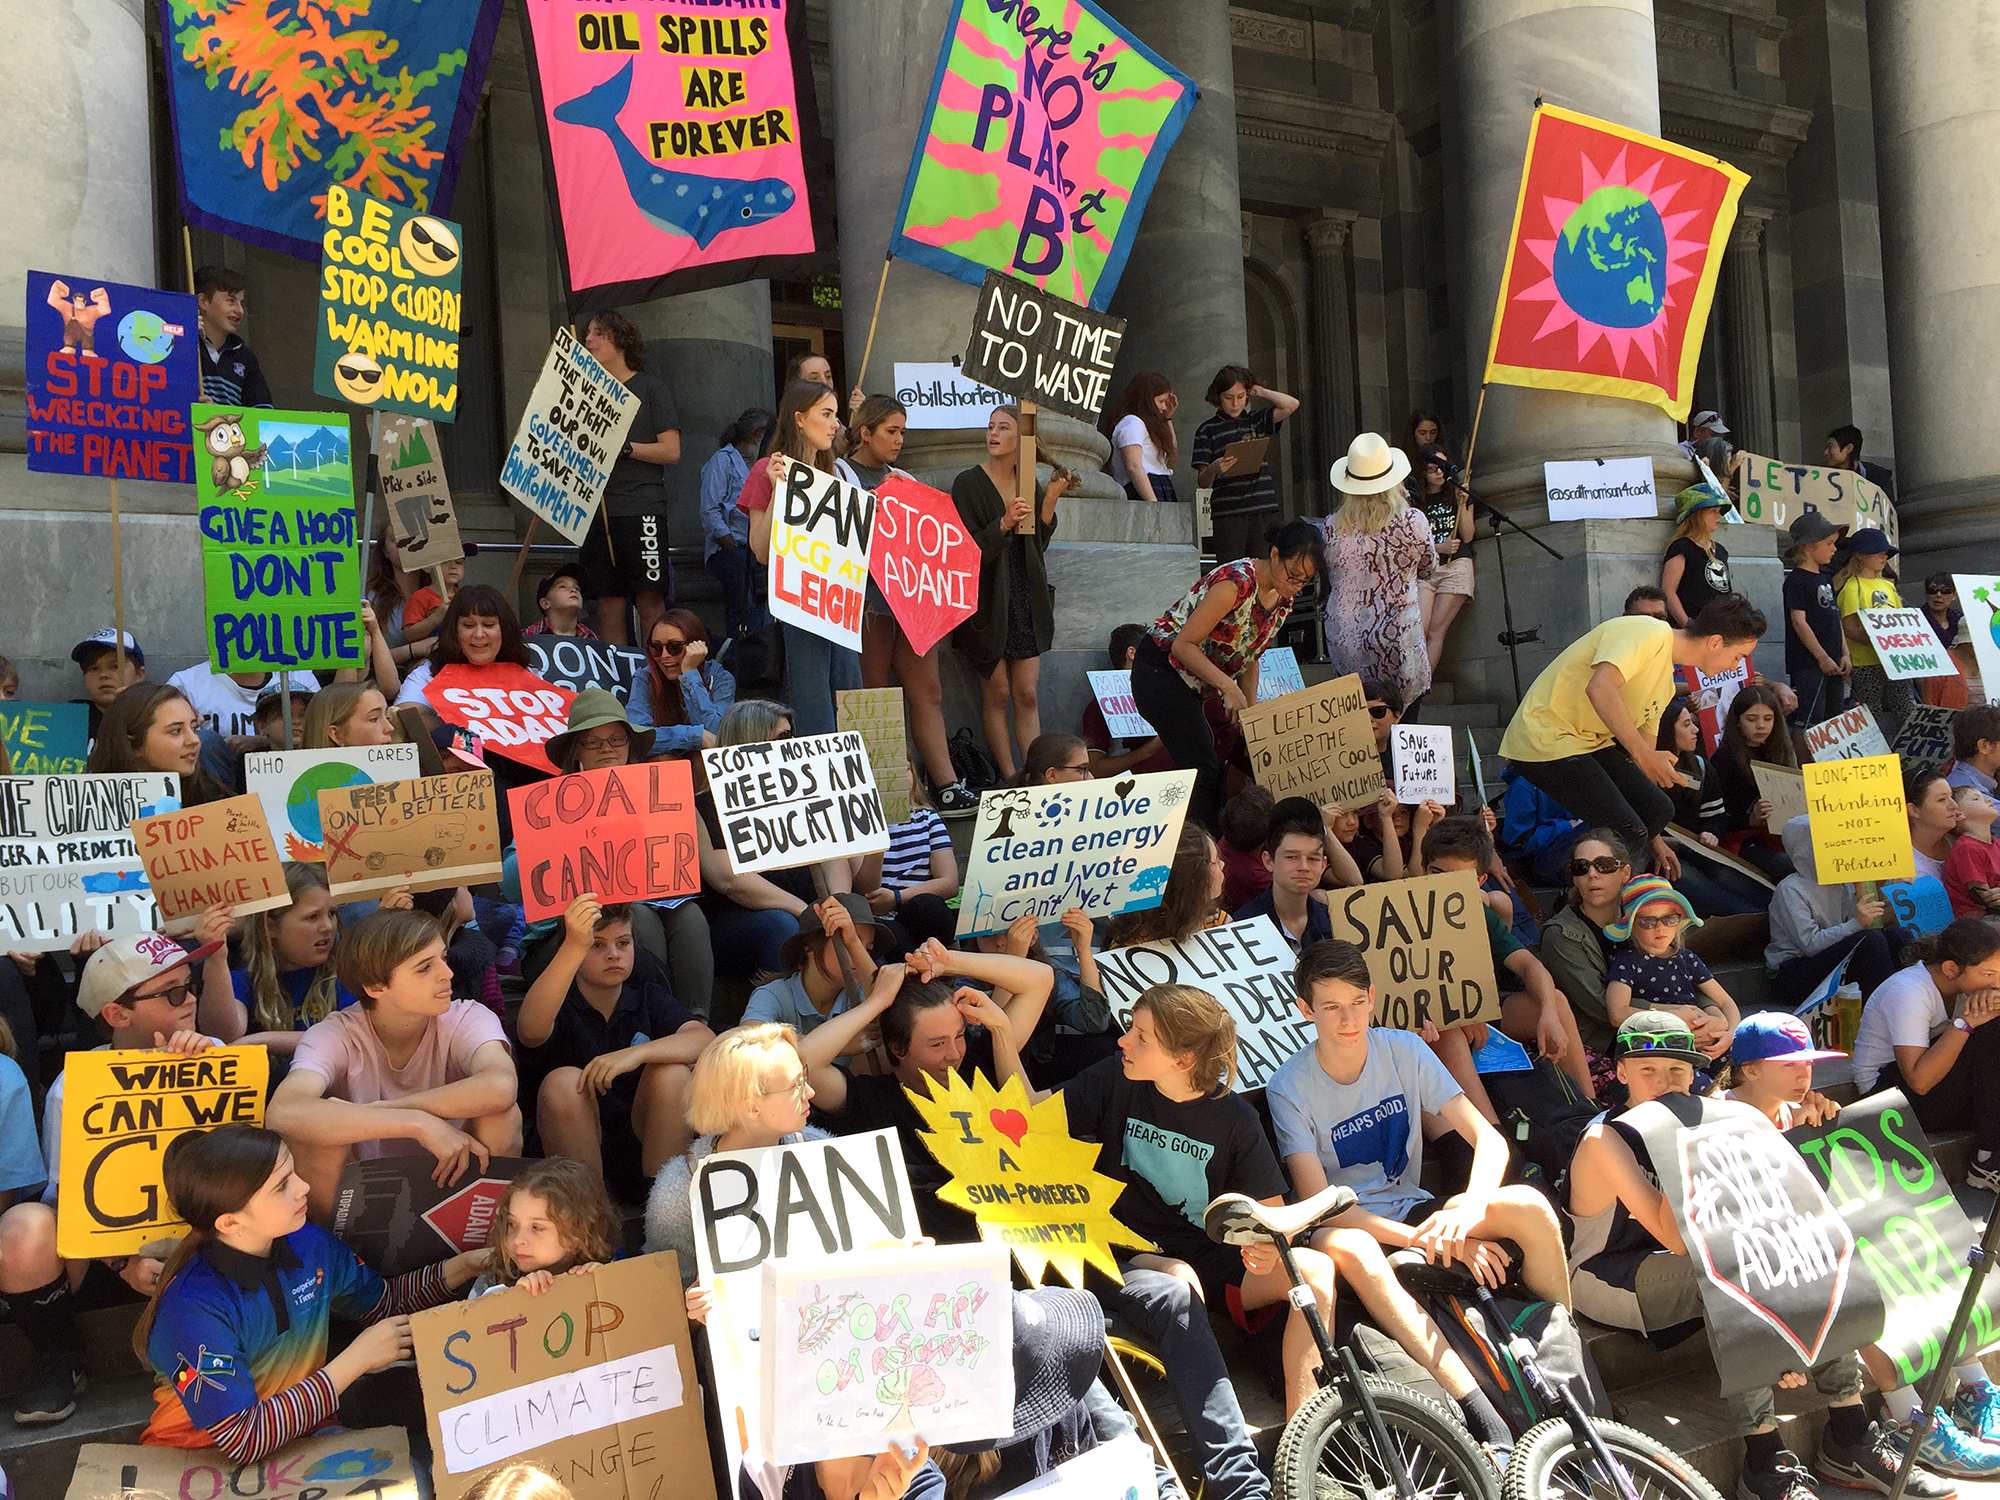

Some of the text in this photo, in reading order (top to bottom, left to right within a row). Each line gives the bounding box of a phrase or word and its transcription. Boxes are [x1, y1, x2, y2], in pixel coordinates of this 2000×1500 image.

[578, 14, 768, 56] OIL SPILLS
[685, 69, 745, 108] ARE
[1023, 43, 1083, 131] NO
[1082, 43, 1117, 90] is
[650, 109, 792, 159] FOREVER
[327, 184, 393, 244] BE
[1012, 184, 1065, 276] B
[323, 229, 416, 279] COOL
[322, 265, 388, 314] STOP
[163, 323, 183, 336] HELP
[327, 307, 459, 369] WARMING
[987, 286, 1122, 368] NO TIME
[46, 351, 168, 404] STOP
[383, 363, 458, 412] NOW
[552, 351, 621, 425] THAT WE HAVE
[980, 330, 1111, 413] TO WASTE
[26, 394, 186, 436] WRECKING
[549, 405, 608, 465] OUR OWN
[575, 400, 612, 438] FIGHT
[27, 430, 78, 455] THE
[529, 413, 607, 489] GOVERNMENT
[503, 444, 588, 532] ENVIRONMENT
[541, 449, 574, 486] SAVE
[574, 475, 595, 502] THE
[1746, 457, 1844, 502] LET'S
[1856, 479, 1895, 535] SAVE
[199, 505, 357, 549] GIVE A HOOT
[784, 461, 876, 556] BAN
[878, 496, 963, 564] STOP
[640, 515, 661, 582] adidas
[772, 520, 866, 587] UCG AT
[230, 550, 344, 601] DON'T
[775, 555, 863, 634] LEIGH
[884, 552, 973, 610] ADANI
[213, 611, 359, 669] POLLUTE
[1867, 612, 1920, 629] SCOTTY
[1877, 632, 1932, 650] DOESN'T
[525, 641, 646, 682] DON'T
[1702, 667, 1744, 687] CHANGE
[1890, 654, 1939, 671] KNOW
[443, 687, 566, 720] STOP
[1245, 689, 1366, 744] I LEFT SCHOOL
[465, 716, 569, 747] ADAN
[1253, 727, 1347, 774] TO KEEP THE
[8, 751, 86, 775] LANET
[250, 747, 414, 775] WHO CARES
[707, 743, 774, 779] SCOTT
[781, 733, 862, 761] MORRISON
[1267, 755, 1332, 793] PLANET
[1814, 763, 1889, 785] LONG-TERM
[350, 774, 495, 810] FEET LIKE CARS
[524, 766, 682, 830] COAL
[722, 763, 818, 809] NEEDS
[829, 753, 868, 792] AN
[1331, 770, 1387, 801] ON CLIMATE
[1811, 793, 1903, 814] Thinking
[45, 777, 148, 837] CHANGE
[329, 792, 487, 830] ONLY BETTER!
[727, 788, 886, 864] EDUCATION
[1078, 796, 1151, 822] I love
[37, 845, 50, 866] A
[56, 838, 141, 865] PREDICTI
[144, 815, 204, 849] STOP
[986, 823, 1168, 864] clean energy
[43, 872, 81, 892] OUR
[150, 838, 270, 881] CLIMATE
[531, 833, 697, 908] CANCER
[1004, 857, 1138, 892] and I vote
[1098, 922, 1279, 1002] NO LIFE
[1390, 946, 1456, 984] OUR
[110, 1059, 238, 1090] WHERE
[83, 1090, 258, 1135] CAN WE
[950, 1111, 984, 1144] I
[1332, 1113, 1374, 1142] HEAPS
[999, 1148, 1022, 1172] A
[1125, 1121, 1209, 1161] HEAPS GOOD.
[700, 1134, 906, 1274] BAN
[966, 1182, 1091, 1205] SUN-POWERED
[462, 1194, 497, 1244] ADANI
[1001, 1222, 1087, 1243] COUNTRY
[1732, 1210, 1839, 1293] ADANI
[849, 1293, 913, 1341] OUR
[444, 1300, 624, 1395] STOP
[816, 1347, 864, 1396] OUR
[454, 1366, 658, 1455] CLIMATE
[551, 1431, 656, 1483] ANGE
